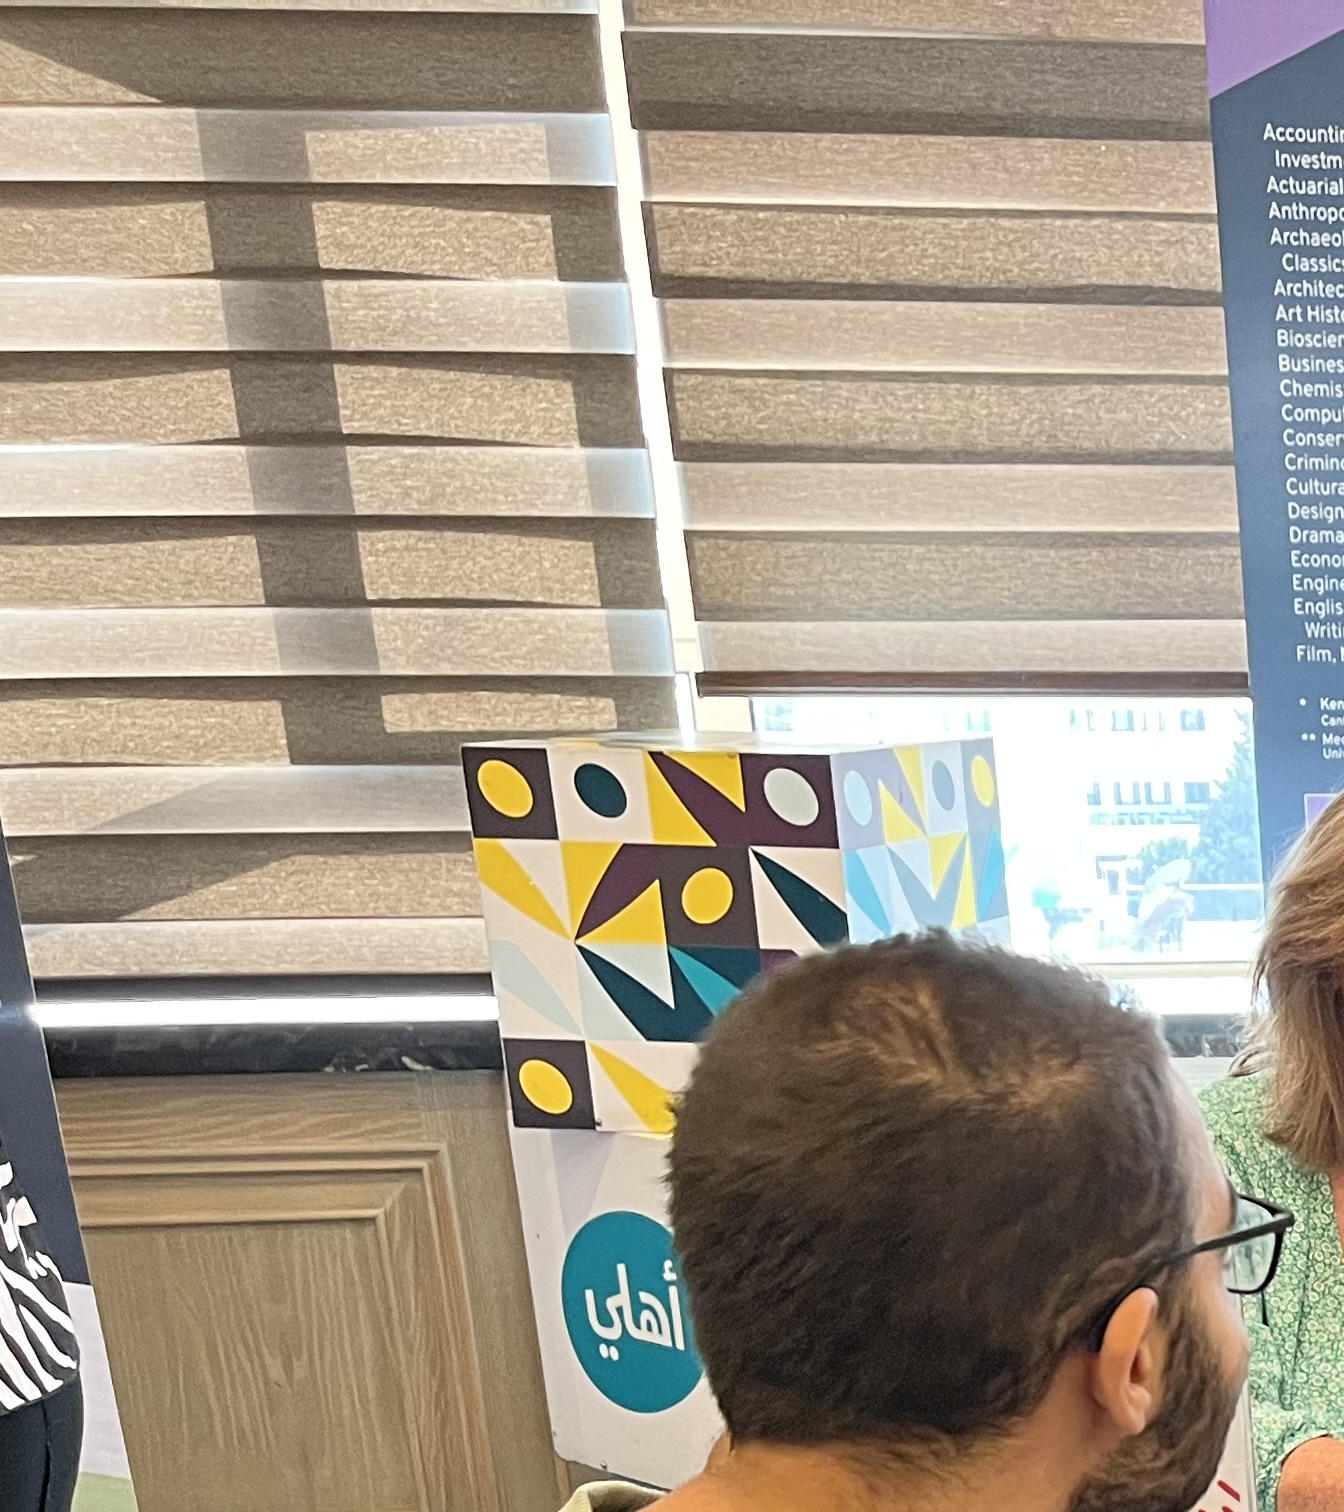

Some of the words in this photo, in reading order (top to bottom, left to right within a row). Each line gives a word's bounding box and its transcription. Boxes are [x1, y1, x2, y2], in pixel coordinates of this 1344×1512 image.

[1267, 175, 1344, 196] Actuarial
[1275, 304, 1303, 322] Art
[1288, 502, 1344, 524] Design
[1289, 525, 1344, 544] Drama
[1297, 645, 1336, 663] Film,
